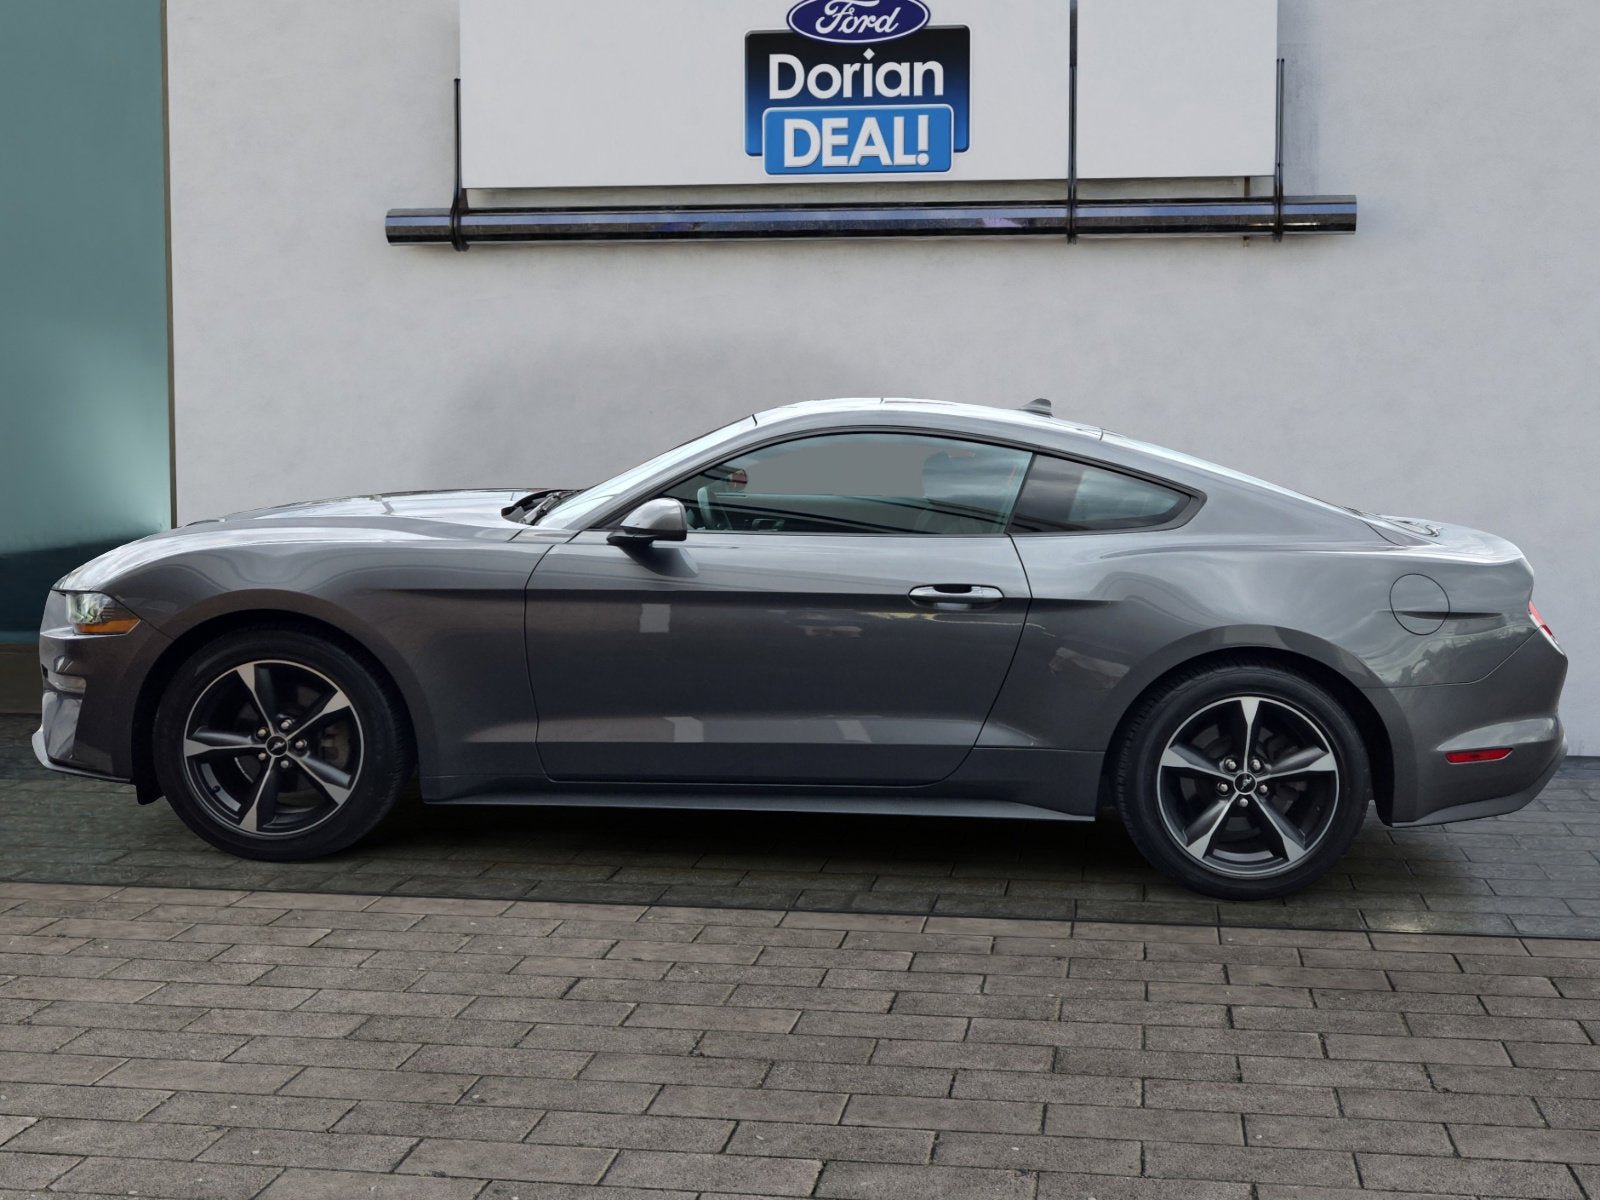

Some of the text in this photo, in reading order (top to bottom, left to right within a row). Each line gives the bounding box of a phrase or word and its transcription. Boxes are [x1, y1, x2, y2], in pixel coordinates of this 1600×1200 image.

[815, 0, 901, 34] Ford
[769, 48, 944, 100] Dorian
[784, 114, 929, 168] DEAL!
